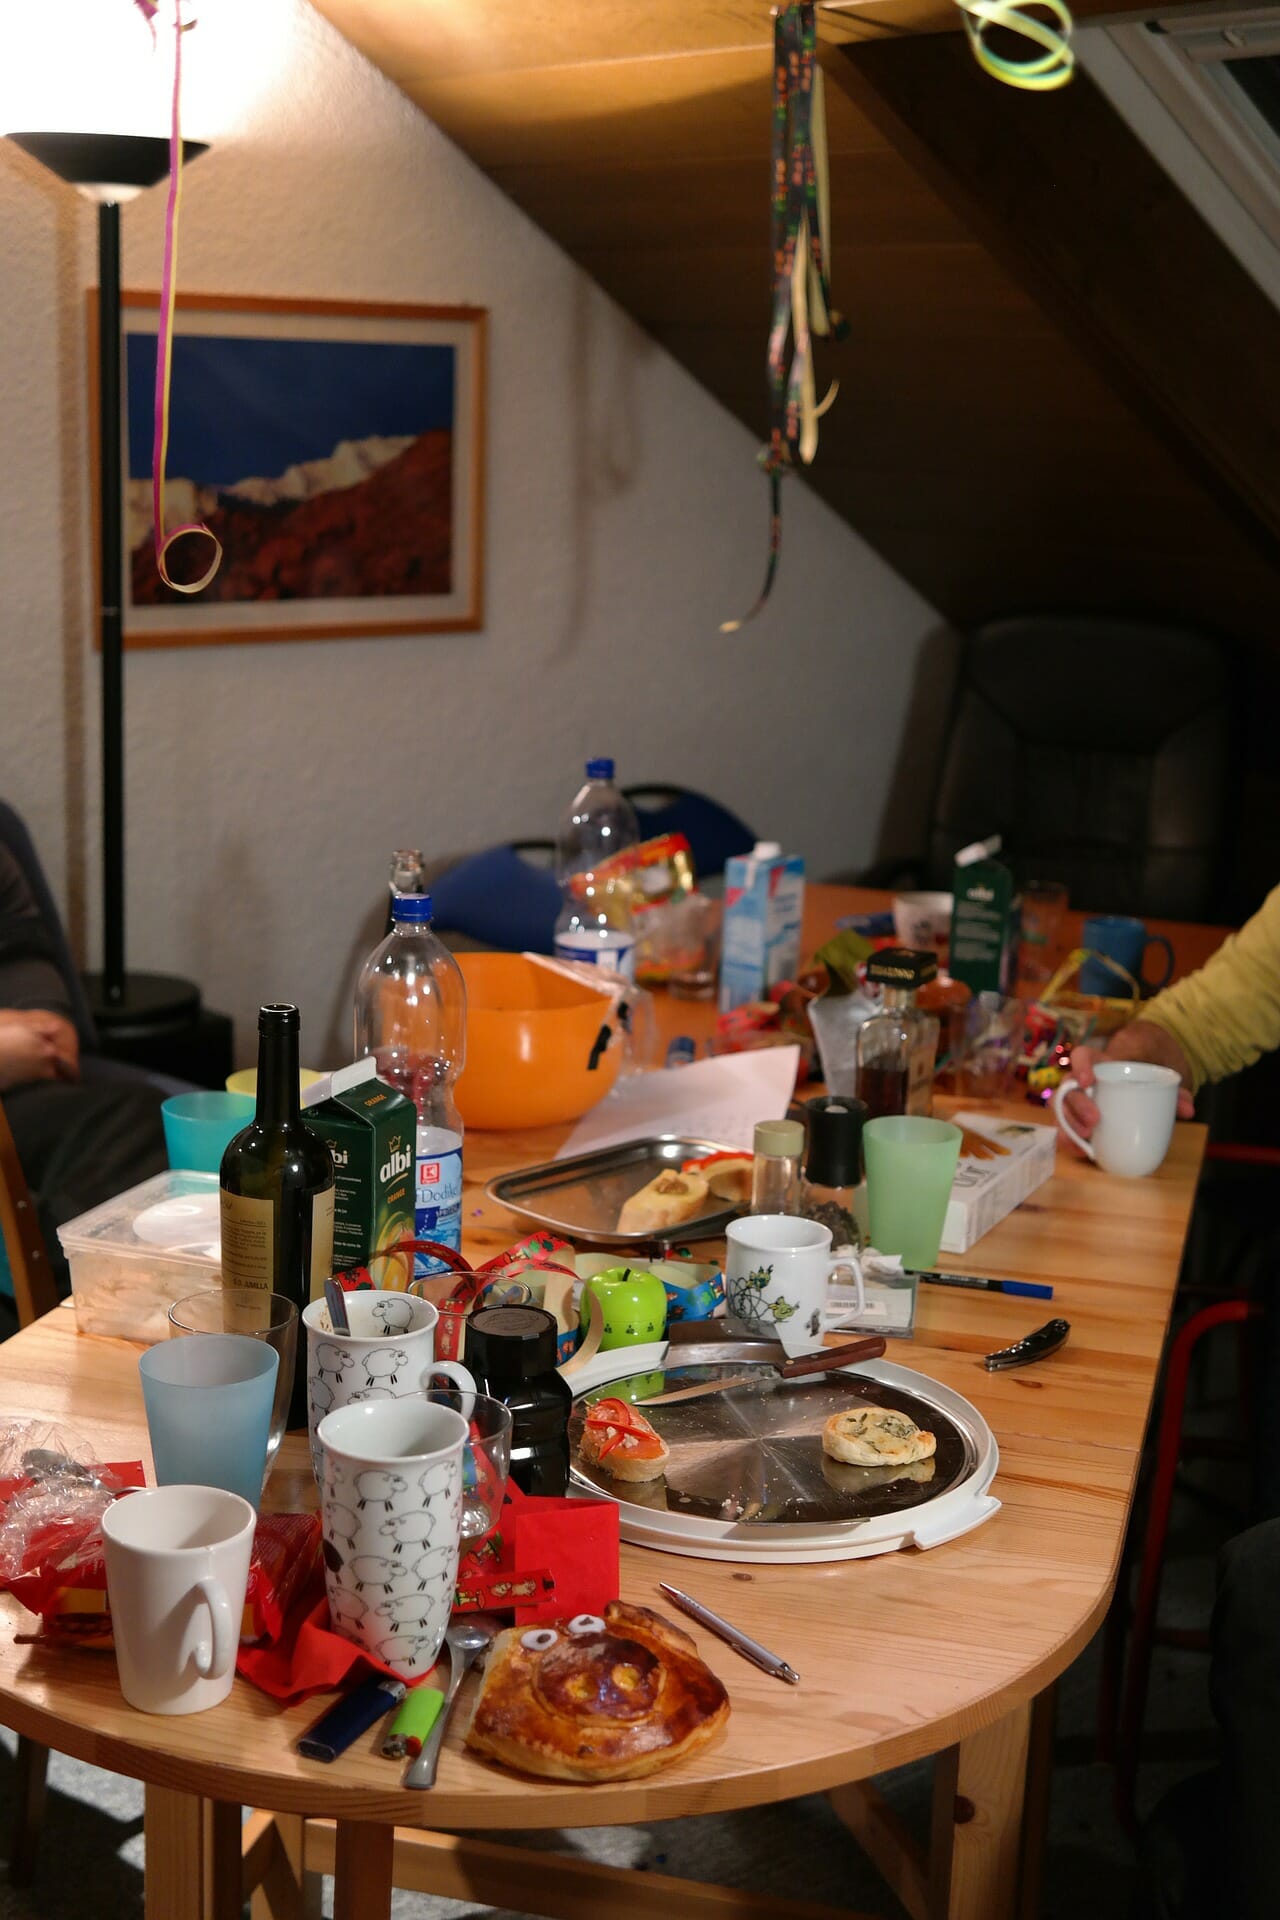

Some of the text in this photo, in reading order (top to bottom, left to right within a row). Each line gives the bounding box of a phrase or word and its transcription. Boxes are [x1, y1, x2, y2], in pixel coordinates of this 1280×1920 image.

[331, 1149, 348, 1164] bi
[380, 1144, 411, 1183] albi
[387, 1187, 406, 1204] ORANGE
